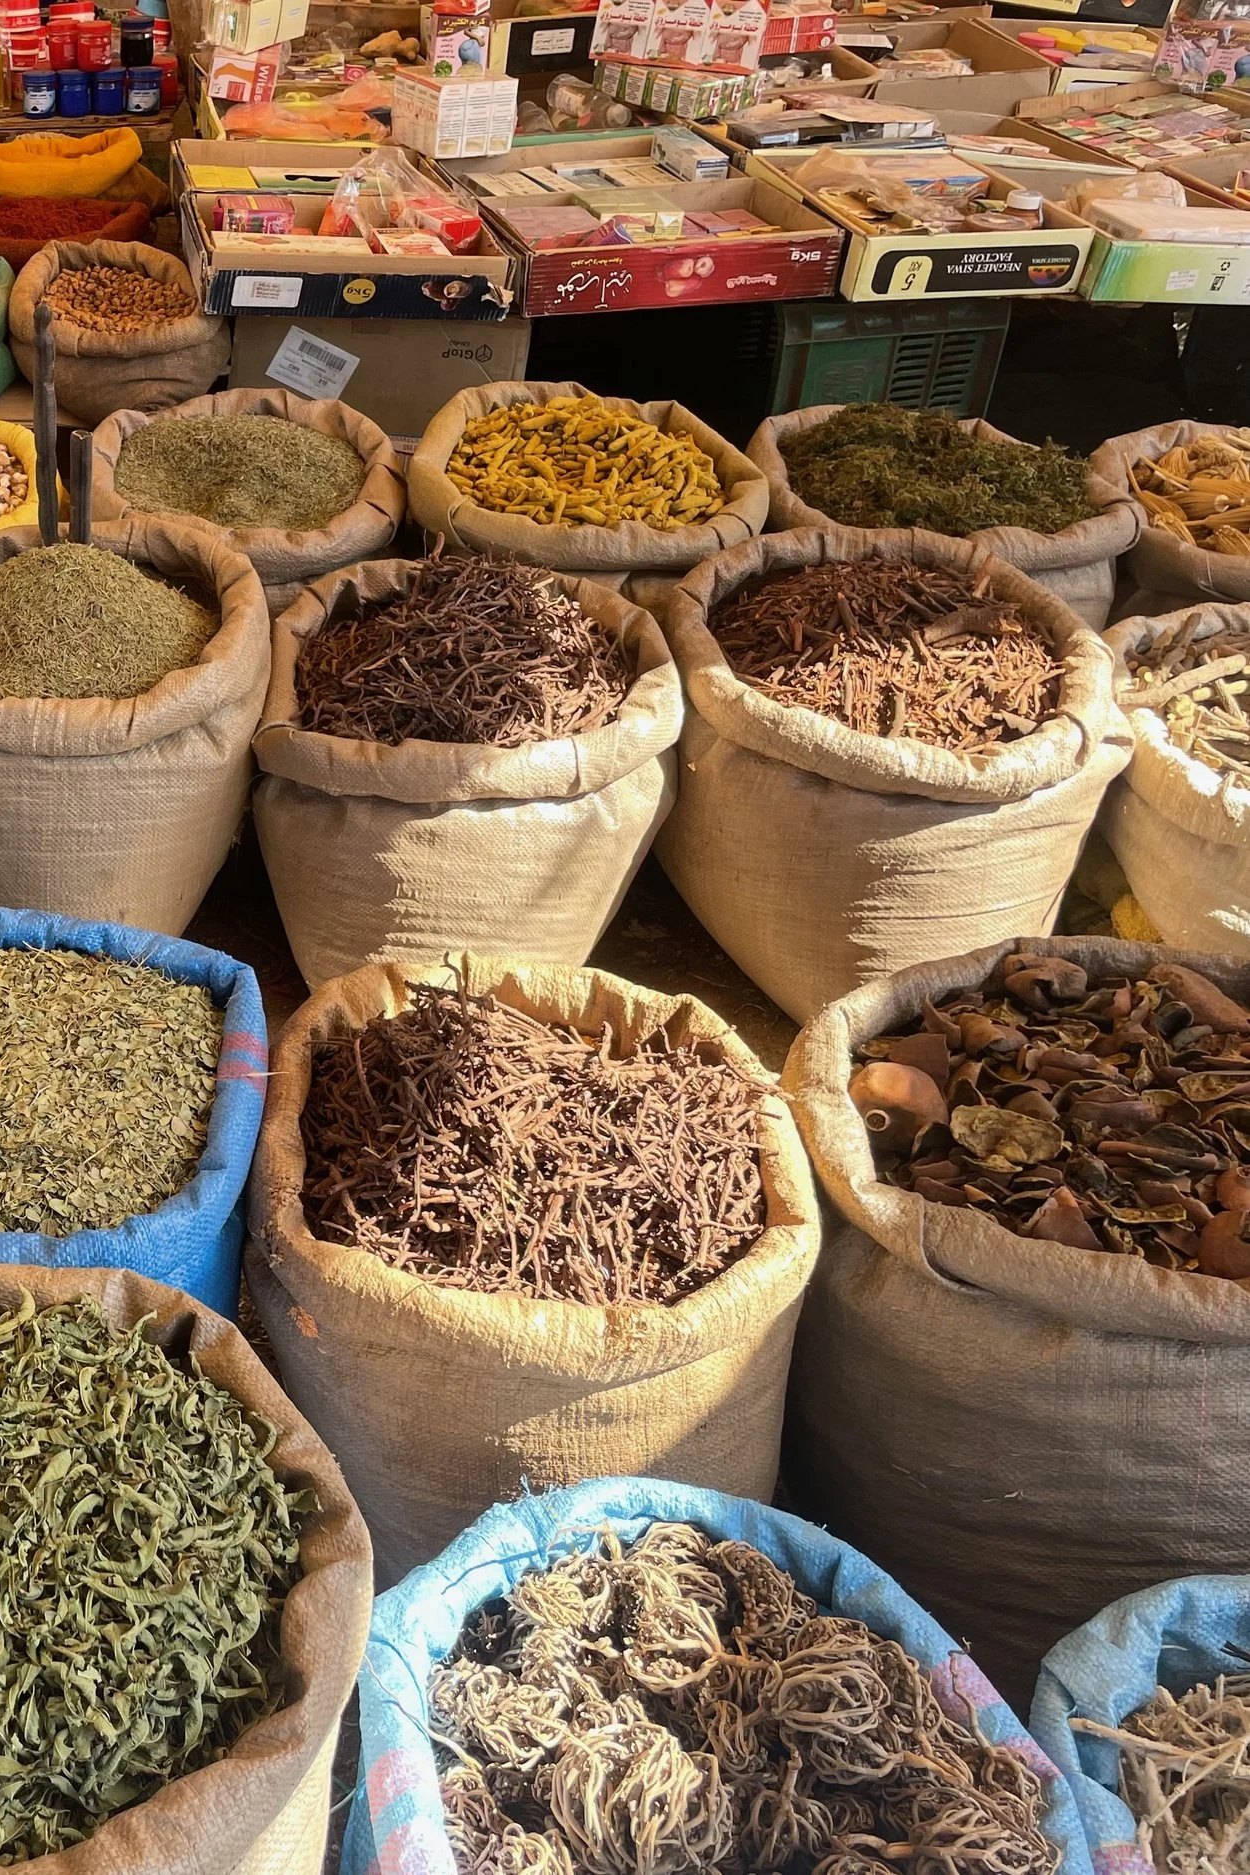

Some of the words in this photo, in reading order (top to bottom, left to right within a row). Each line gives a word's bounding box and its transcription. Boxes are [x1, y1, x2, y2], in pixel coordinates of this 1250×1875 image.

[960, 252, 1014, 264] FACTORY
[909, 261, 923, 272] KG
[947, 263, 974, 274] SIWA
[974, 262, 1022, 274] NEGMET
[901, 273, 916, 291] 5
